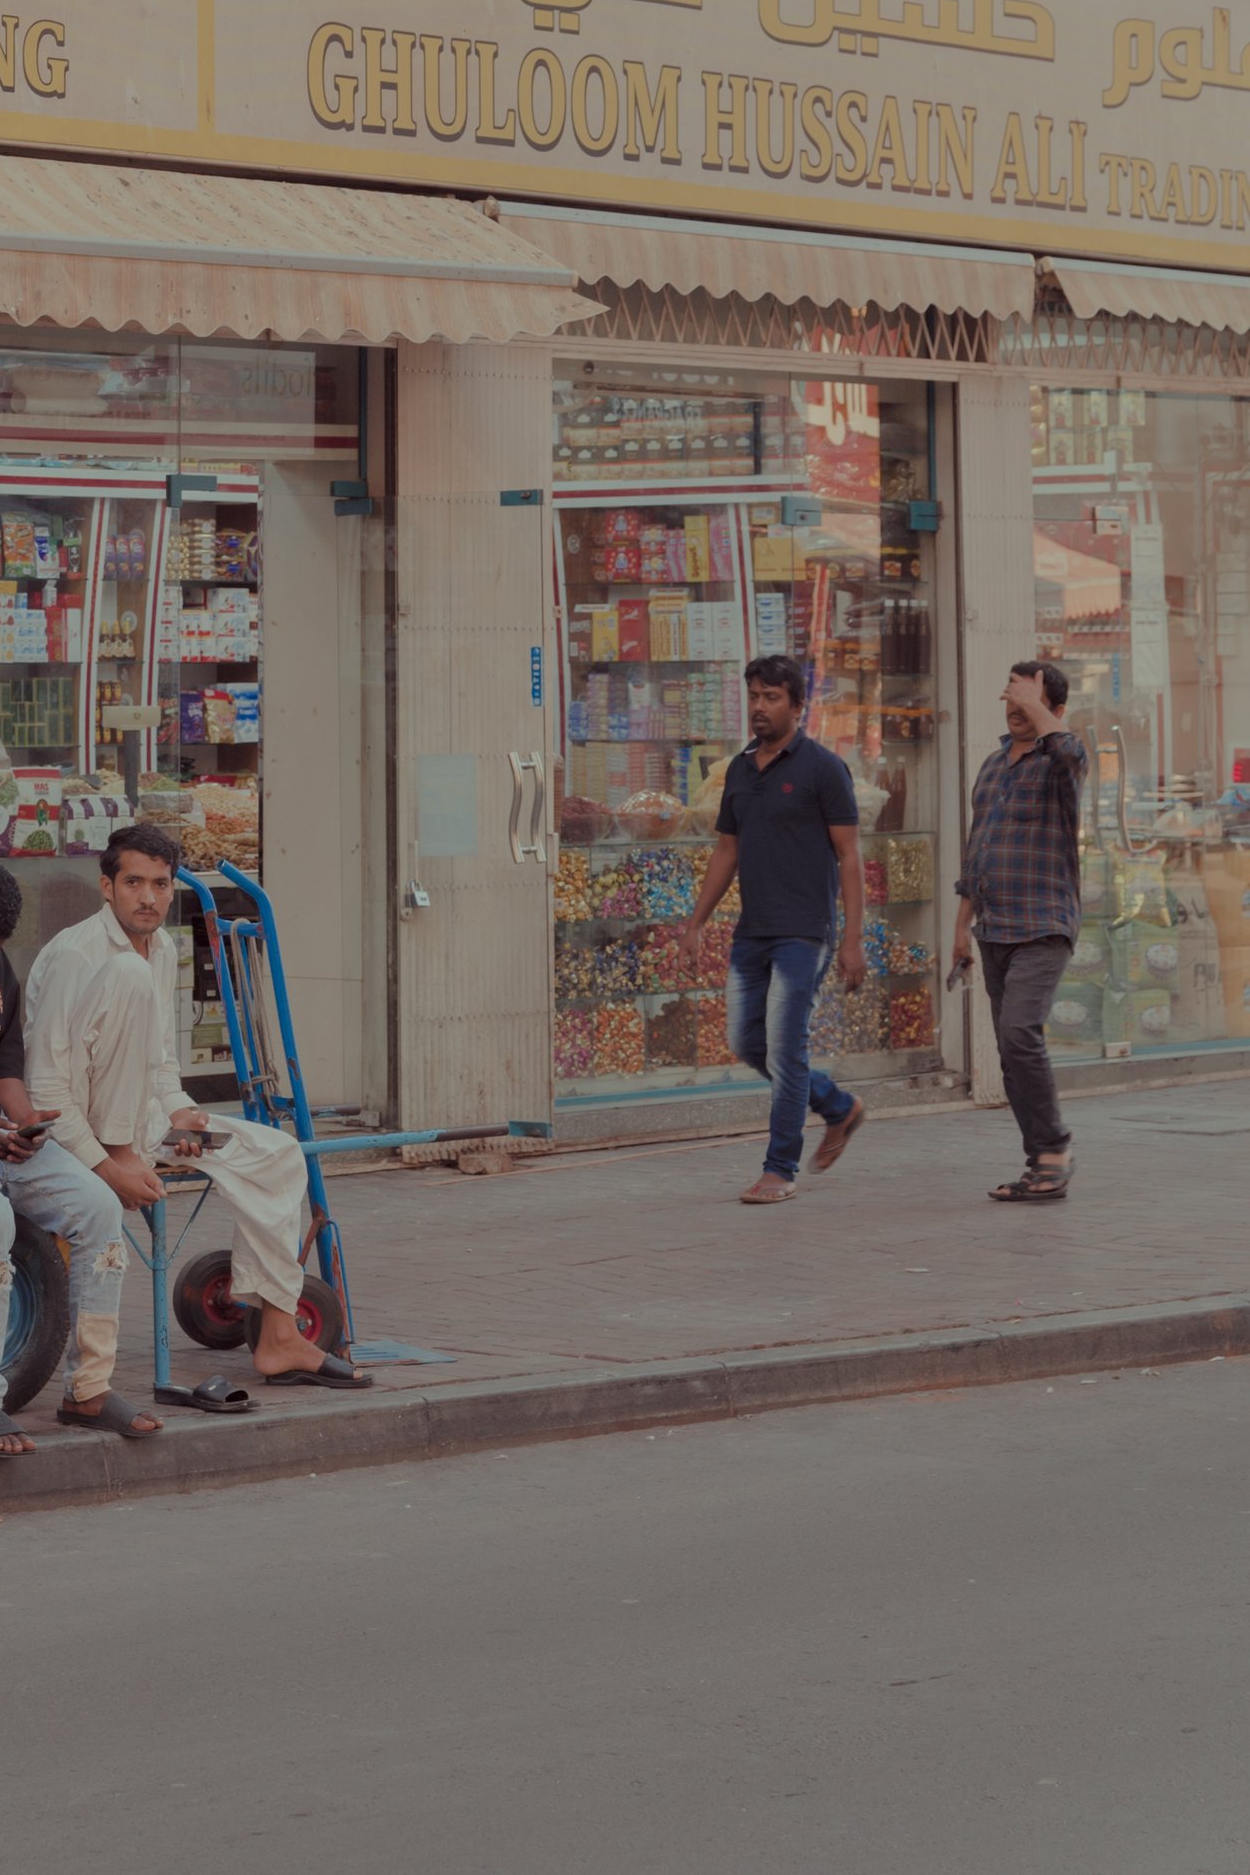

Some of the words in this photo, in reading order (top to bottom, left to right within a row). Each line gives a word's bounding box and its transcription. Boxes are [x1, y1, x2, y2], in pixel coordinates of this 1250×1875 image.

[307, 22, 682, 165] GHULOOM
[701, 71, 977, 200] HUSSAIN
[989, 111, 1088, 213] ALI
[1102, 7, 1250, 109] لوم
